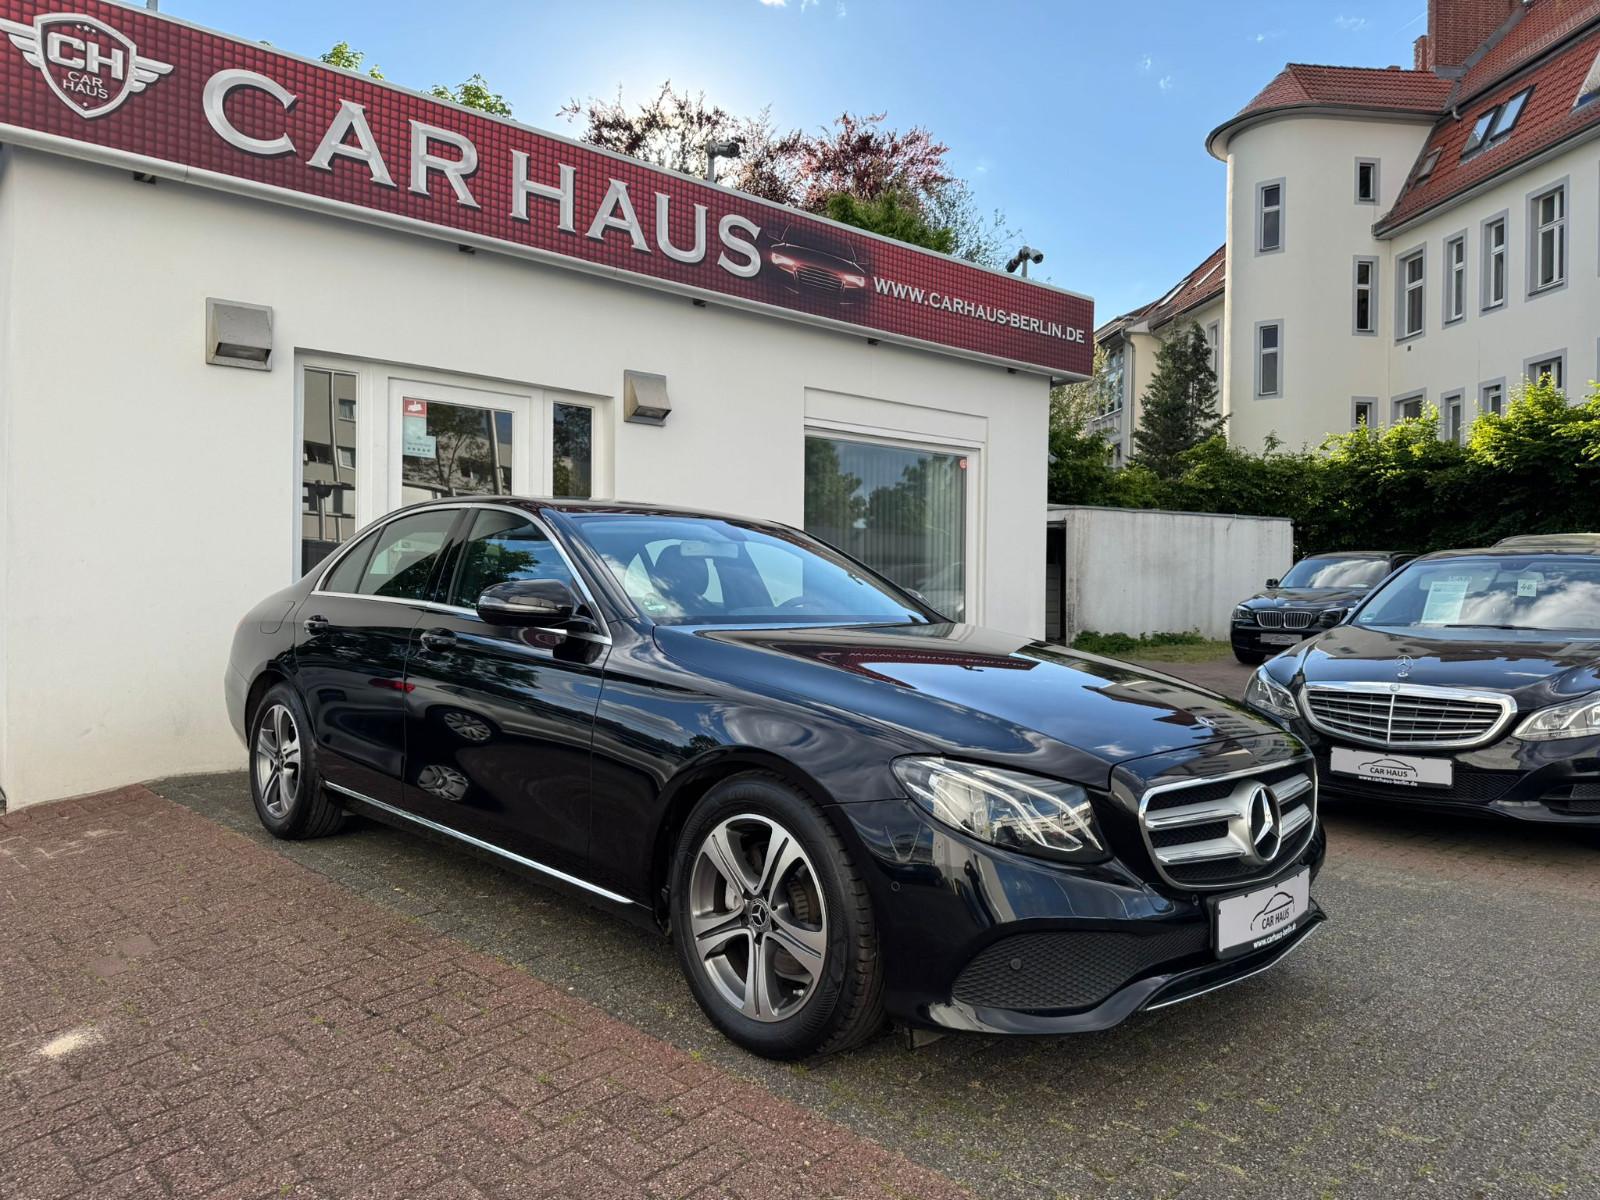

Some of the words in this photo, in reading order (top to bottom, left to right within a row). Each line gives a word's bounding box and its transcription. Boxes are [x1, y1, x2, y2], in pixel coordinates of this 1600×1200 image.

[47, 31, 124, 81] CH
[63, 80, 109, 99] HAUS
[67, 71, 103, 88] CAR
[202, 68, 480, 209] CAR
[509, 148, 762, 278] HAUS
[873, 276, 1085, 344] WWW.CARHAUS-BERLIN.DE
[1370, 767, 1385, 775] CAR
[1386, 769, 1408, 778] HAUS
[1261, 915, 1274, 930] CAR
[1275, 907, 1290, 924] HAUS
